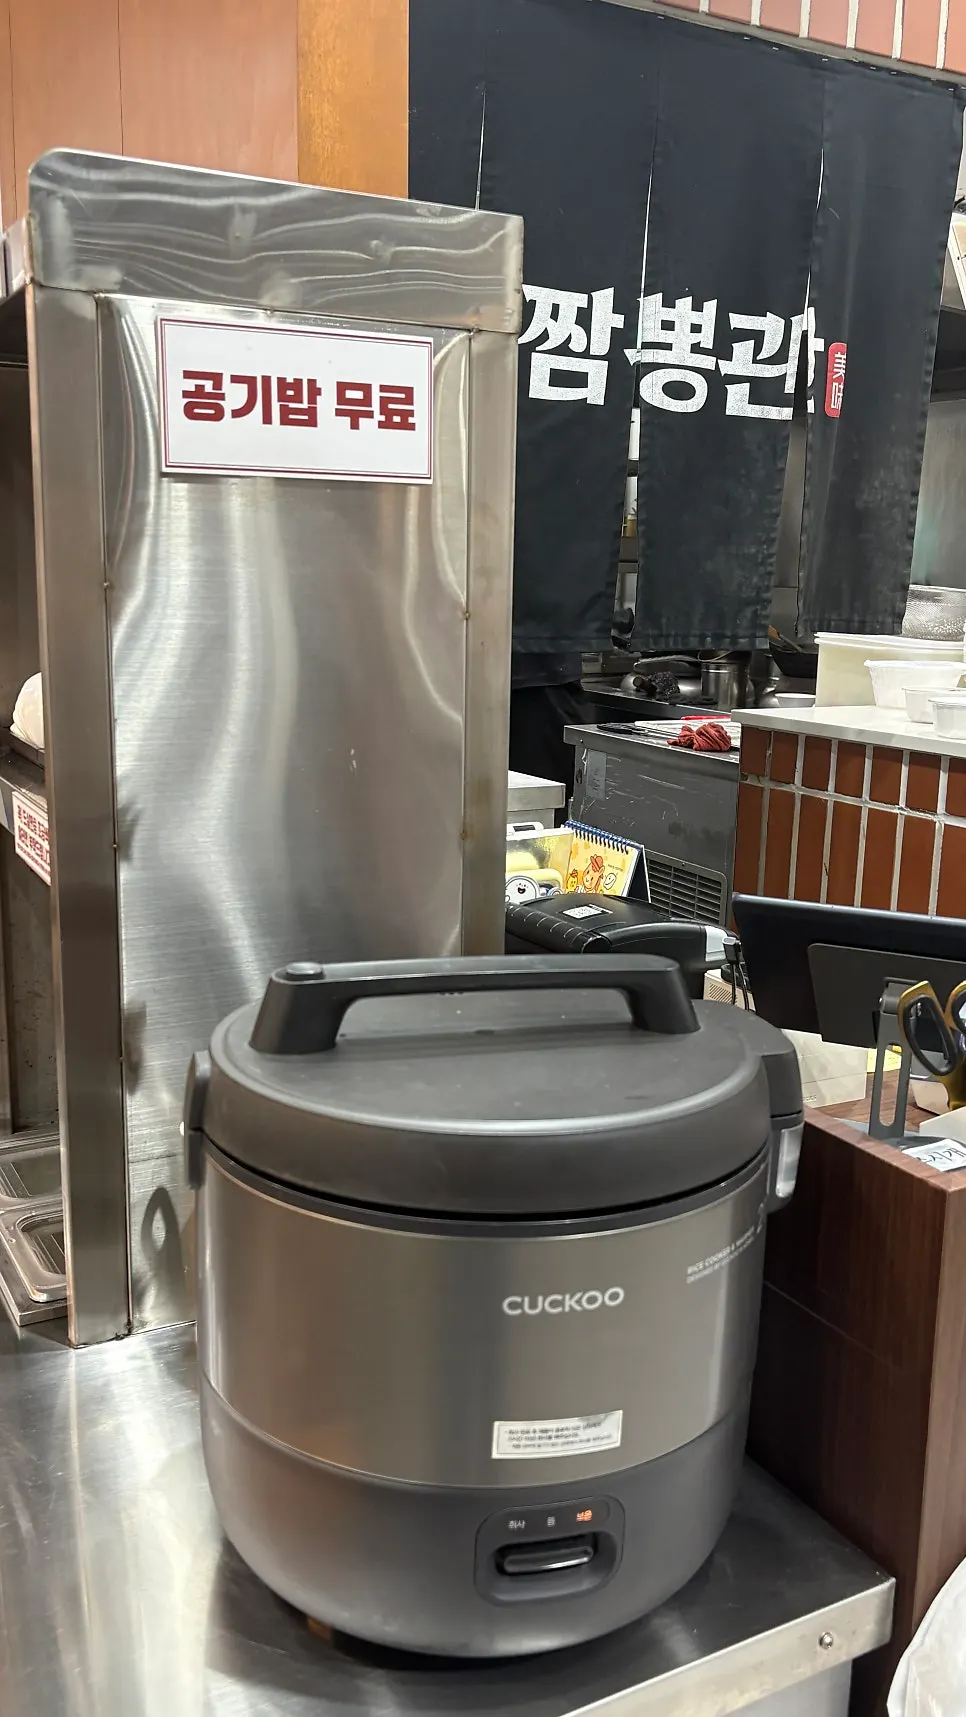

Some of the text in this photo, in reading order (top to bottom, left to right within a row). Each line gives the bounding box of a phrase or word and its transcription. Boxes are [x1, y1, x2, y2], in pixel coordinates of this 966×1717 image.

[518, 284, 824, 421] 짬뽕관
[182, 369, 416, 431] 공기밥 무료
[502, 1286, 625, 1316] CUCKOO
